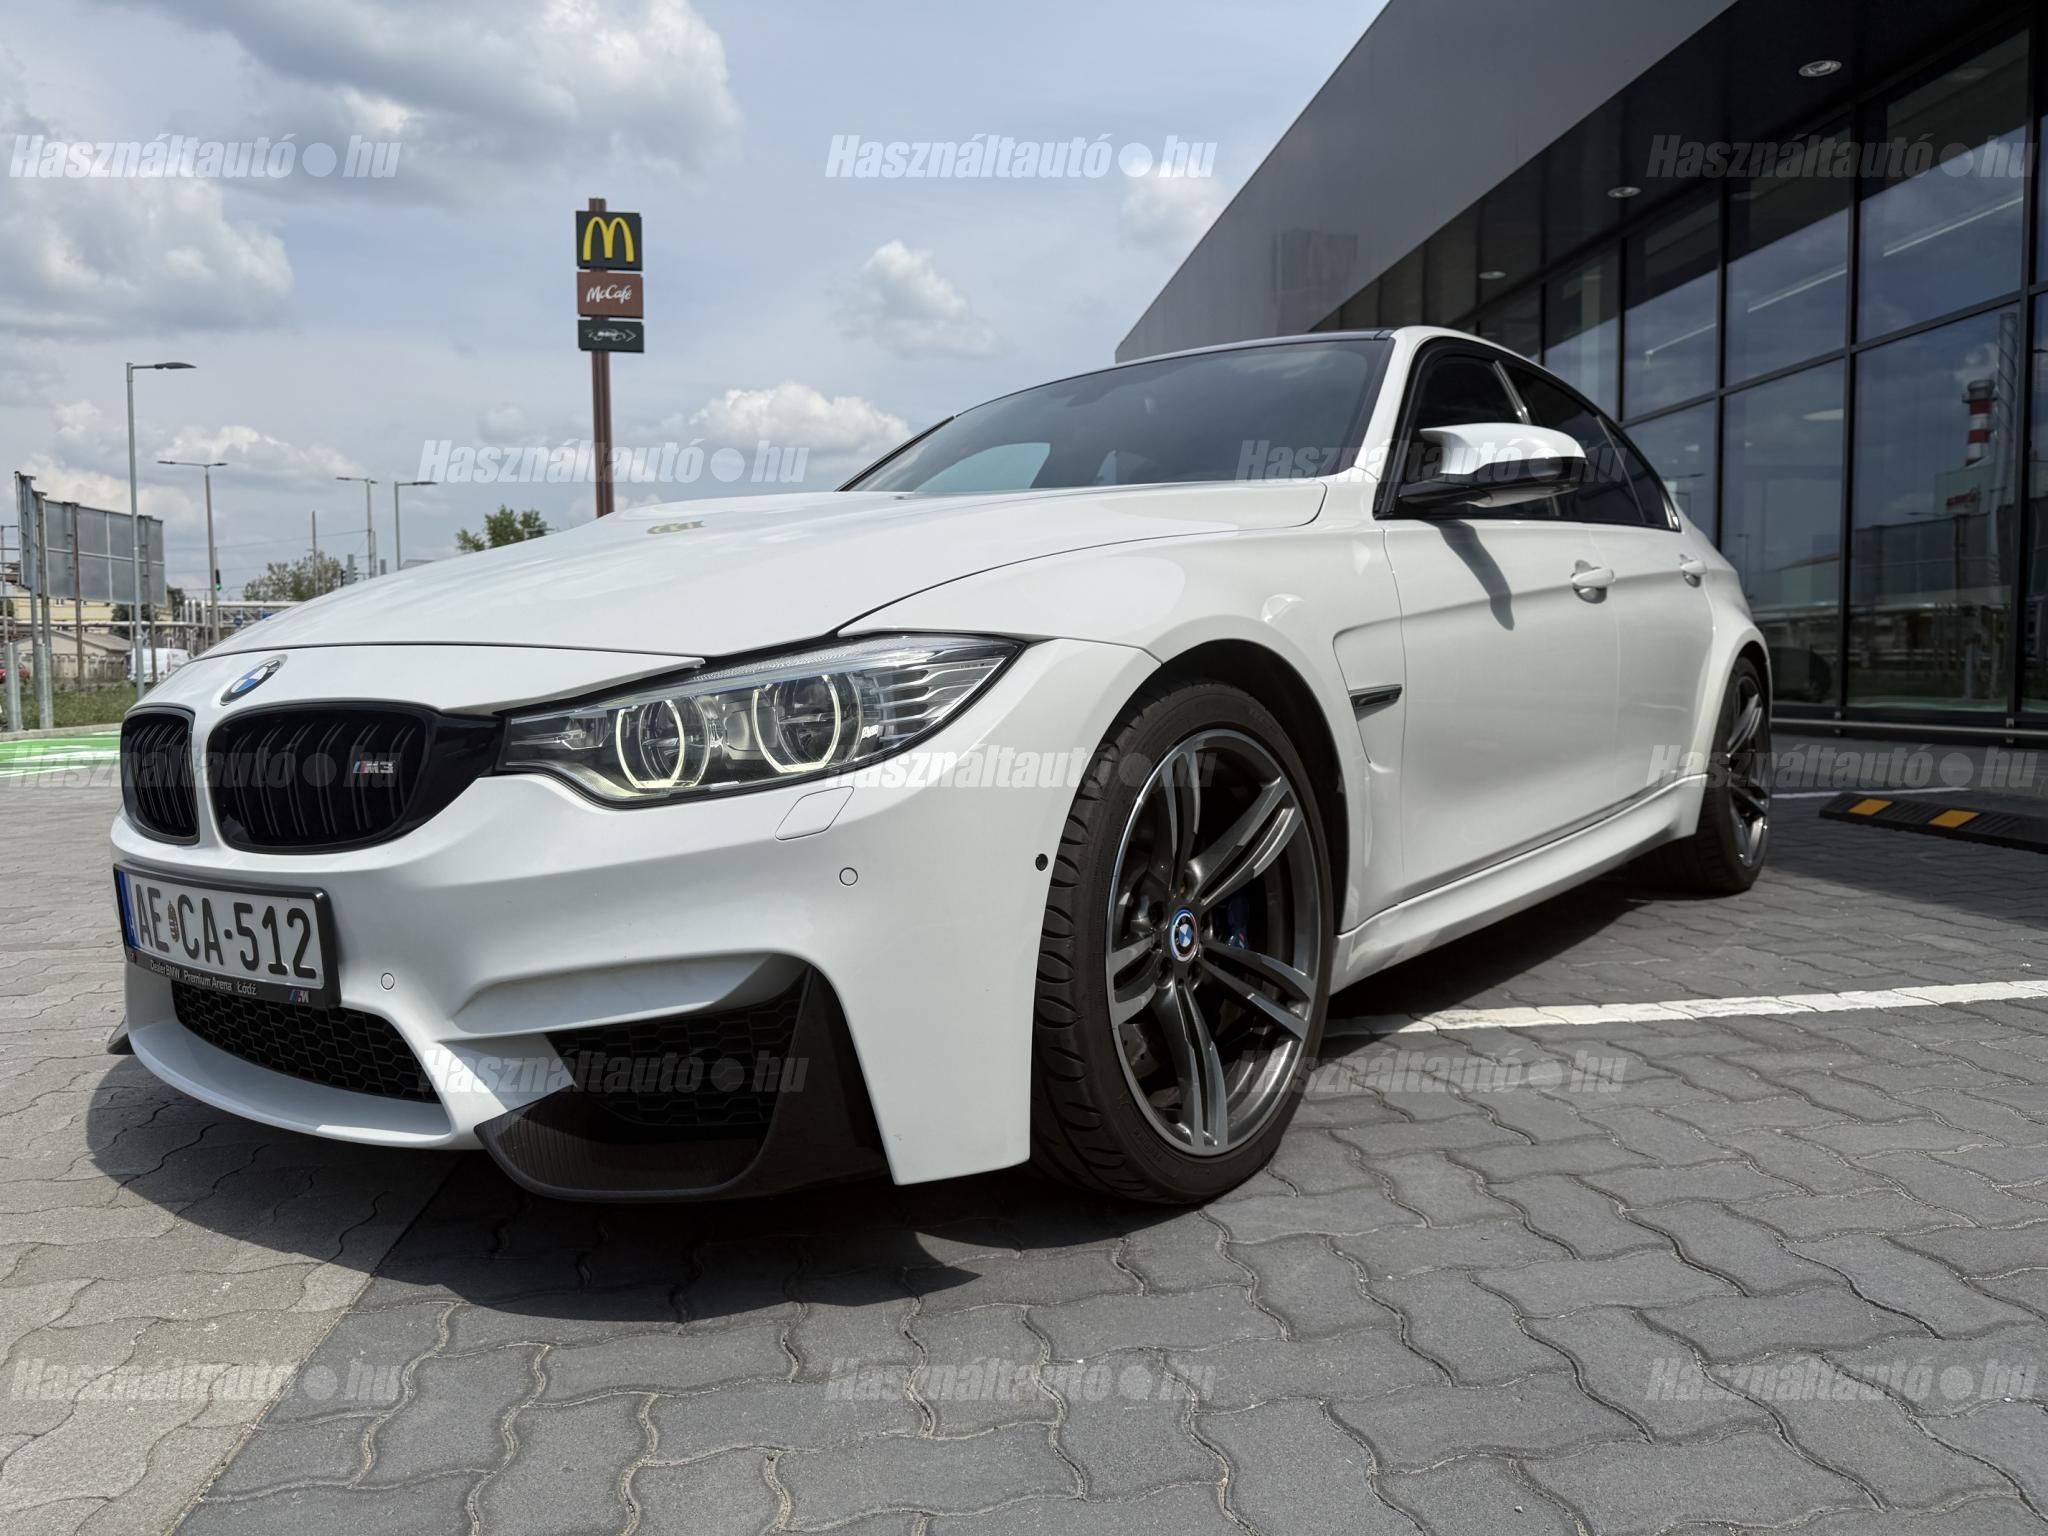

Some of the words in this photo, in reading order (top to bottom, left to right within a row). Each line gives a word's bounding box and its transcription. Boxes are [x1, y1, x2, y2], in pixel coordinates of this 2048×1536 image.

[586, 284, 632, 304] McCafé
[165, 964, 180, 979] BMW
[184, 970, 211, 986] Premium
[211, 977, 232, 991] Arena
